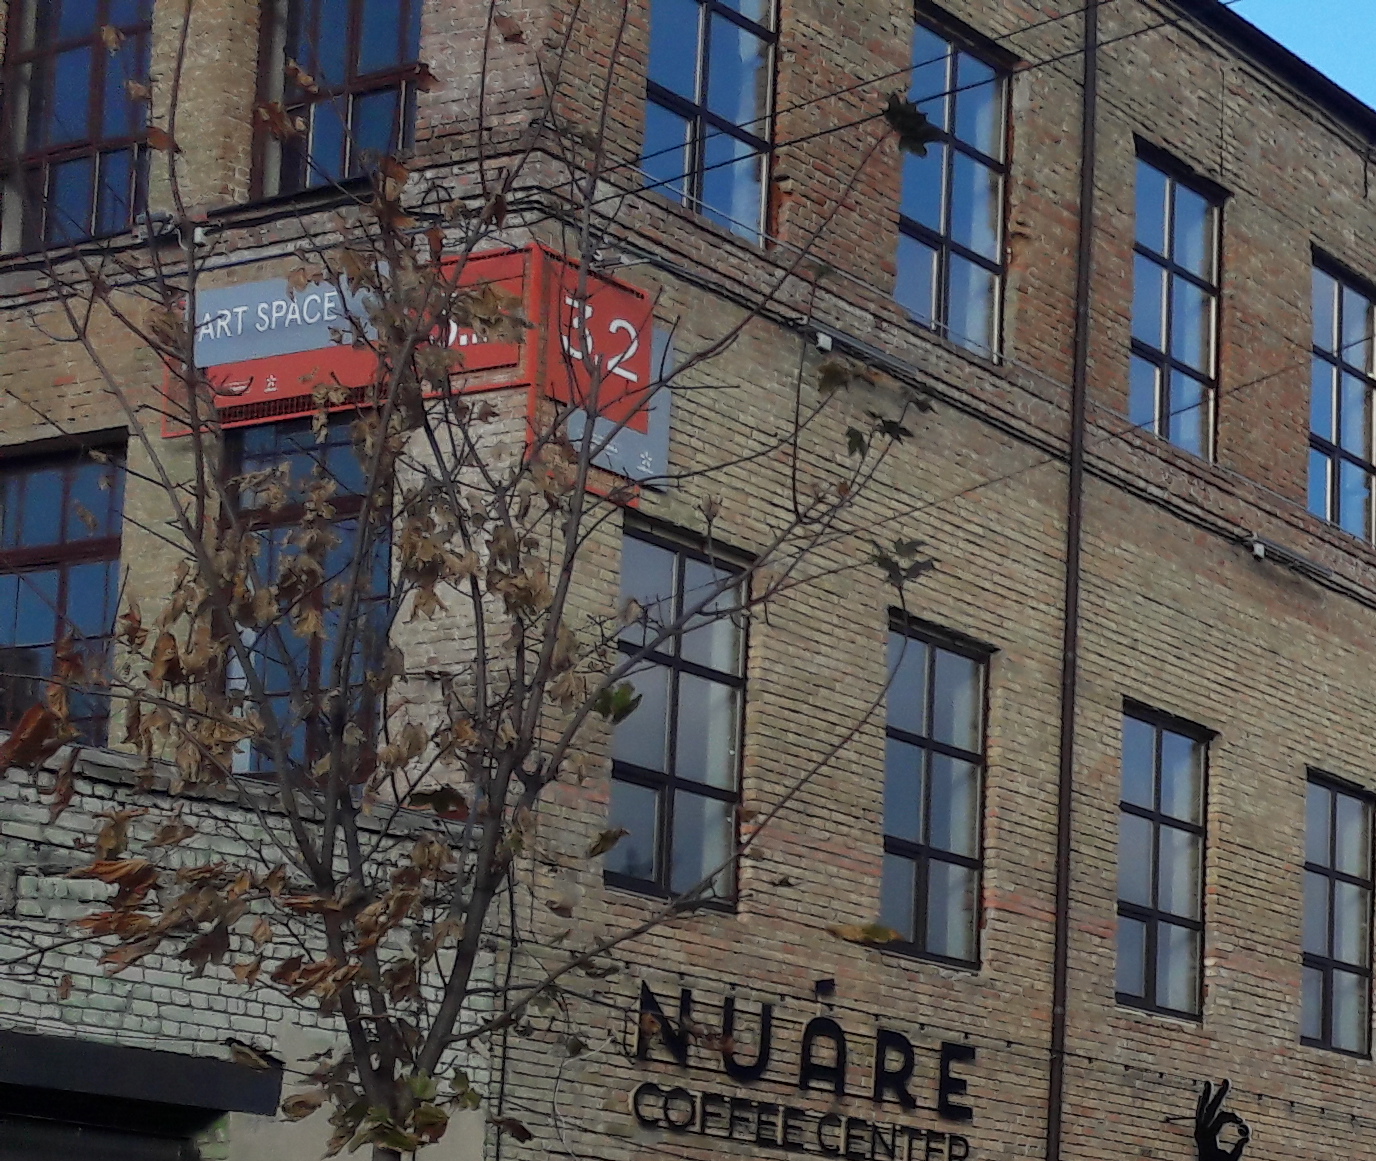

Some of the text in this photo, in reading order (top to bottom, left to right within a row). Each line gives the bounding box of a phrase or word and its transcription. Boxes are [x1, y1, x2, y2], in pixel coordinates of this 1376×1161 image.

[197, 290, 341, 342] ART SPACE
[631, 1081, 806, 1151] COFFEE
